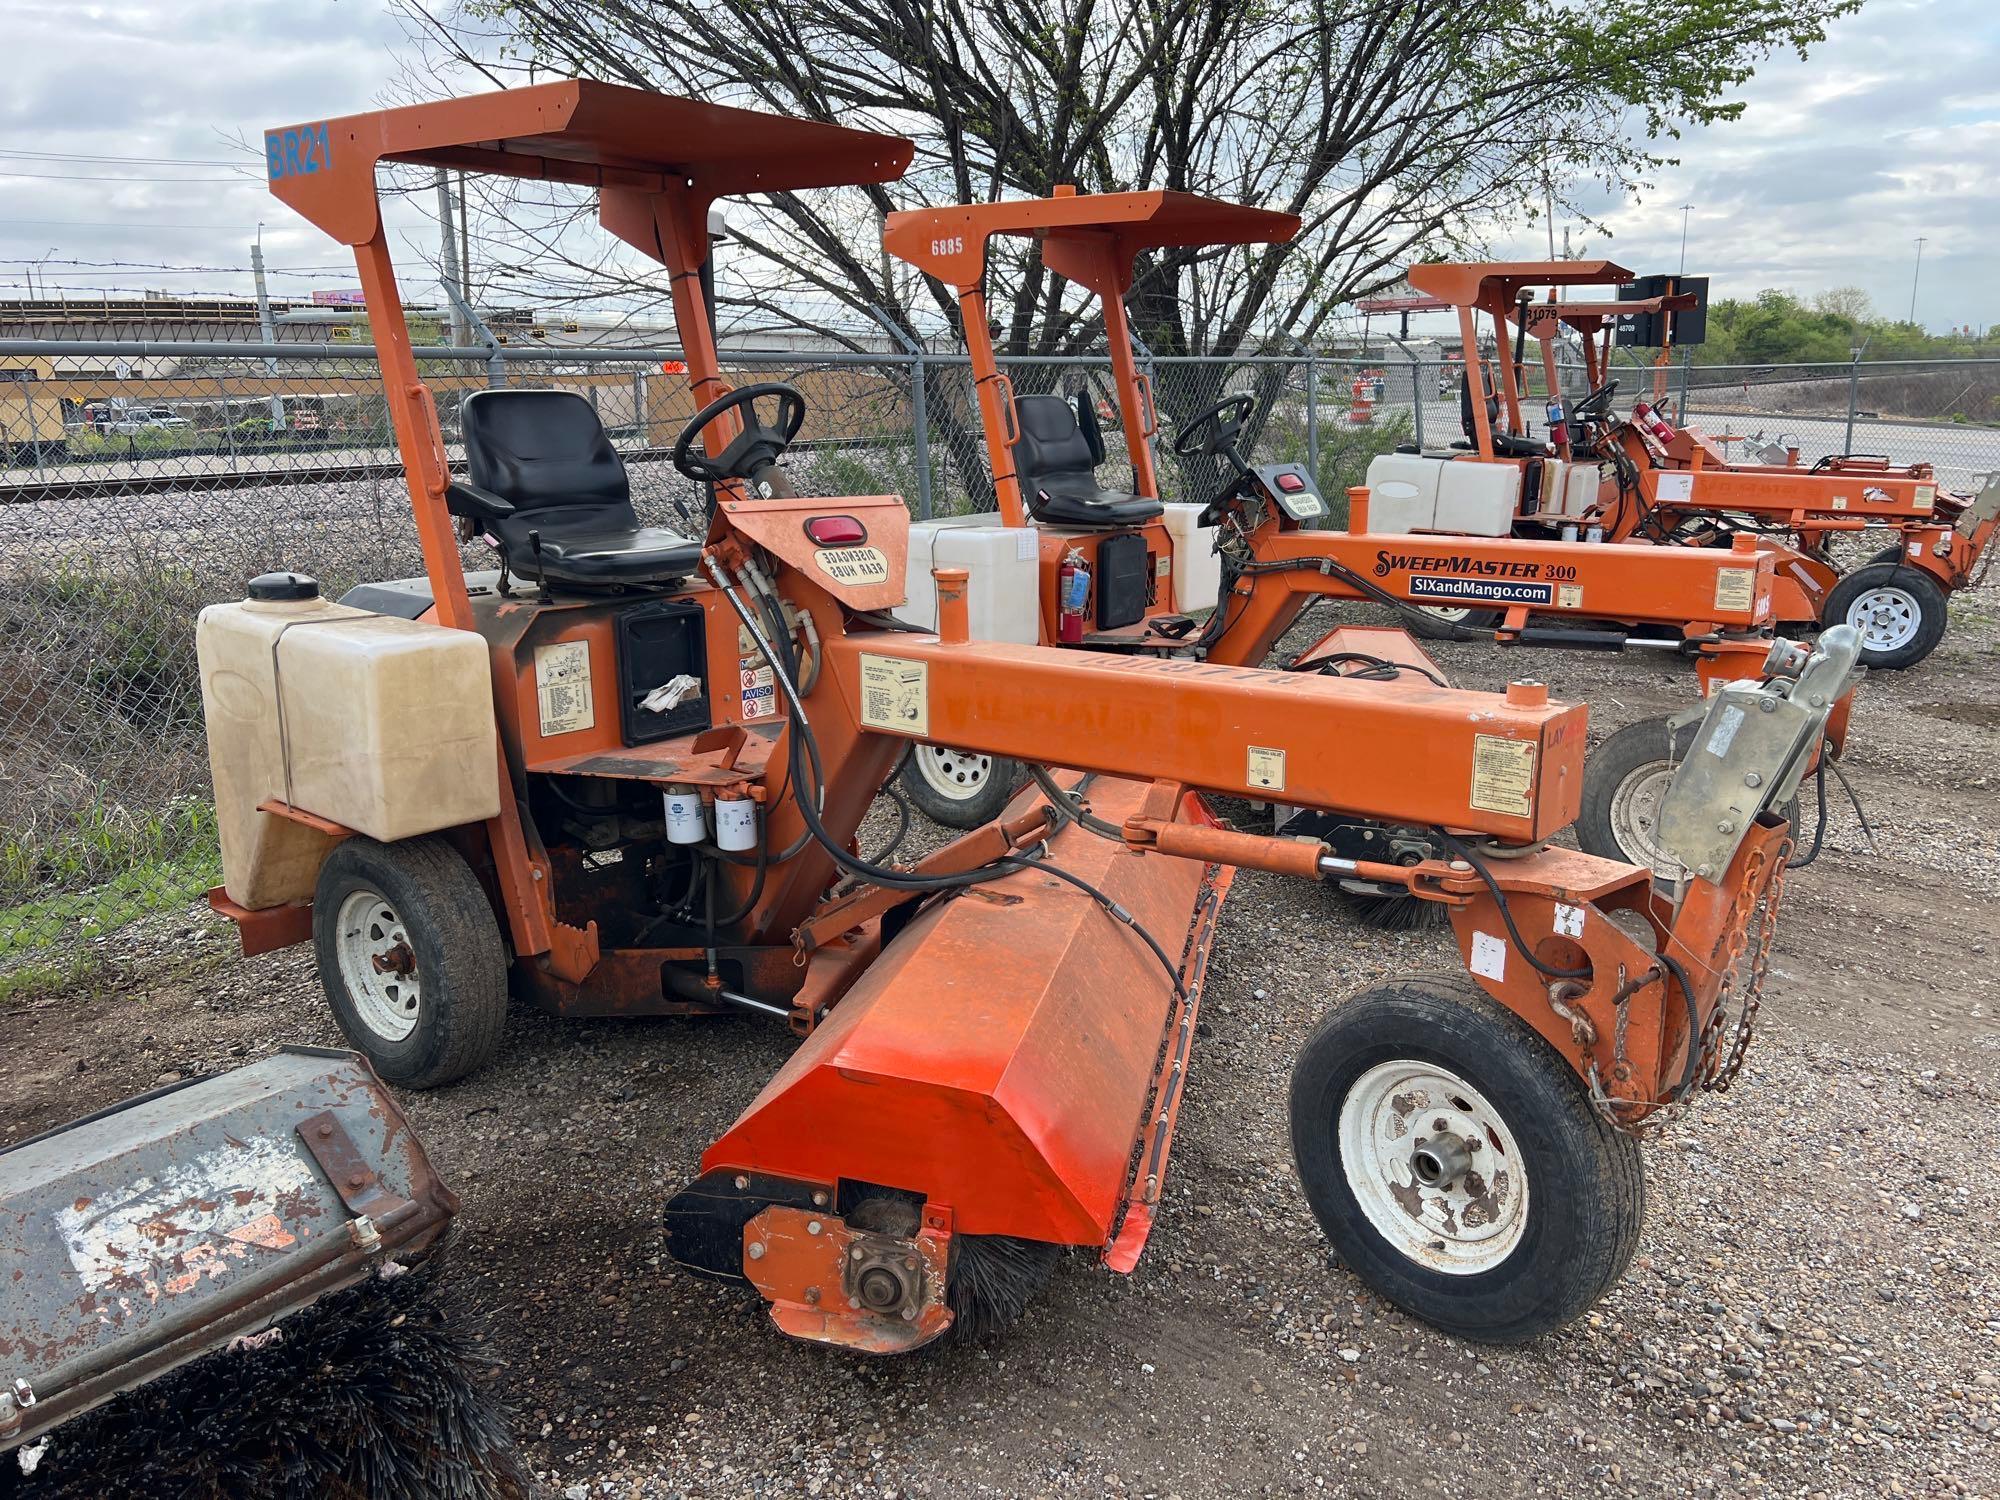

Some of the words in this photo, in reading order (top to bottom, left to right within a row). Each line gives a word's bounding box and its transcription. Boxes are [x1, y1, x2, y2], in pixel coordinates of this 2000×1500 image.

[265, 121, 331, 179] BR21
[931, 237, 963, 256] 6885
[1518, 308, 1557, 320] R1079
[1545, 564, 1577, 580] 300
[1414, 578, 1547, 600] SIXandMango.com
[744, 686, 772, 700] AVISO
